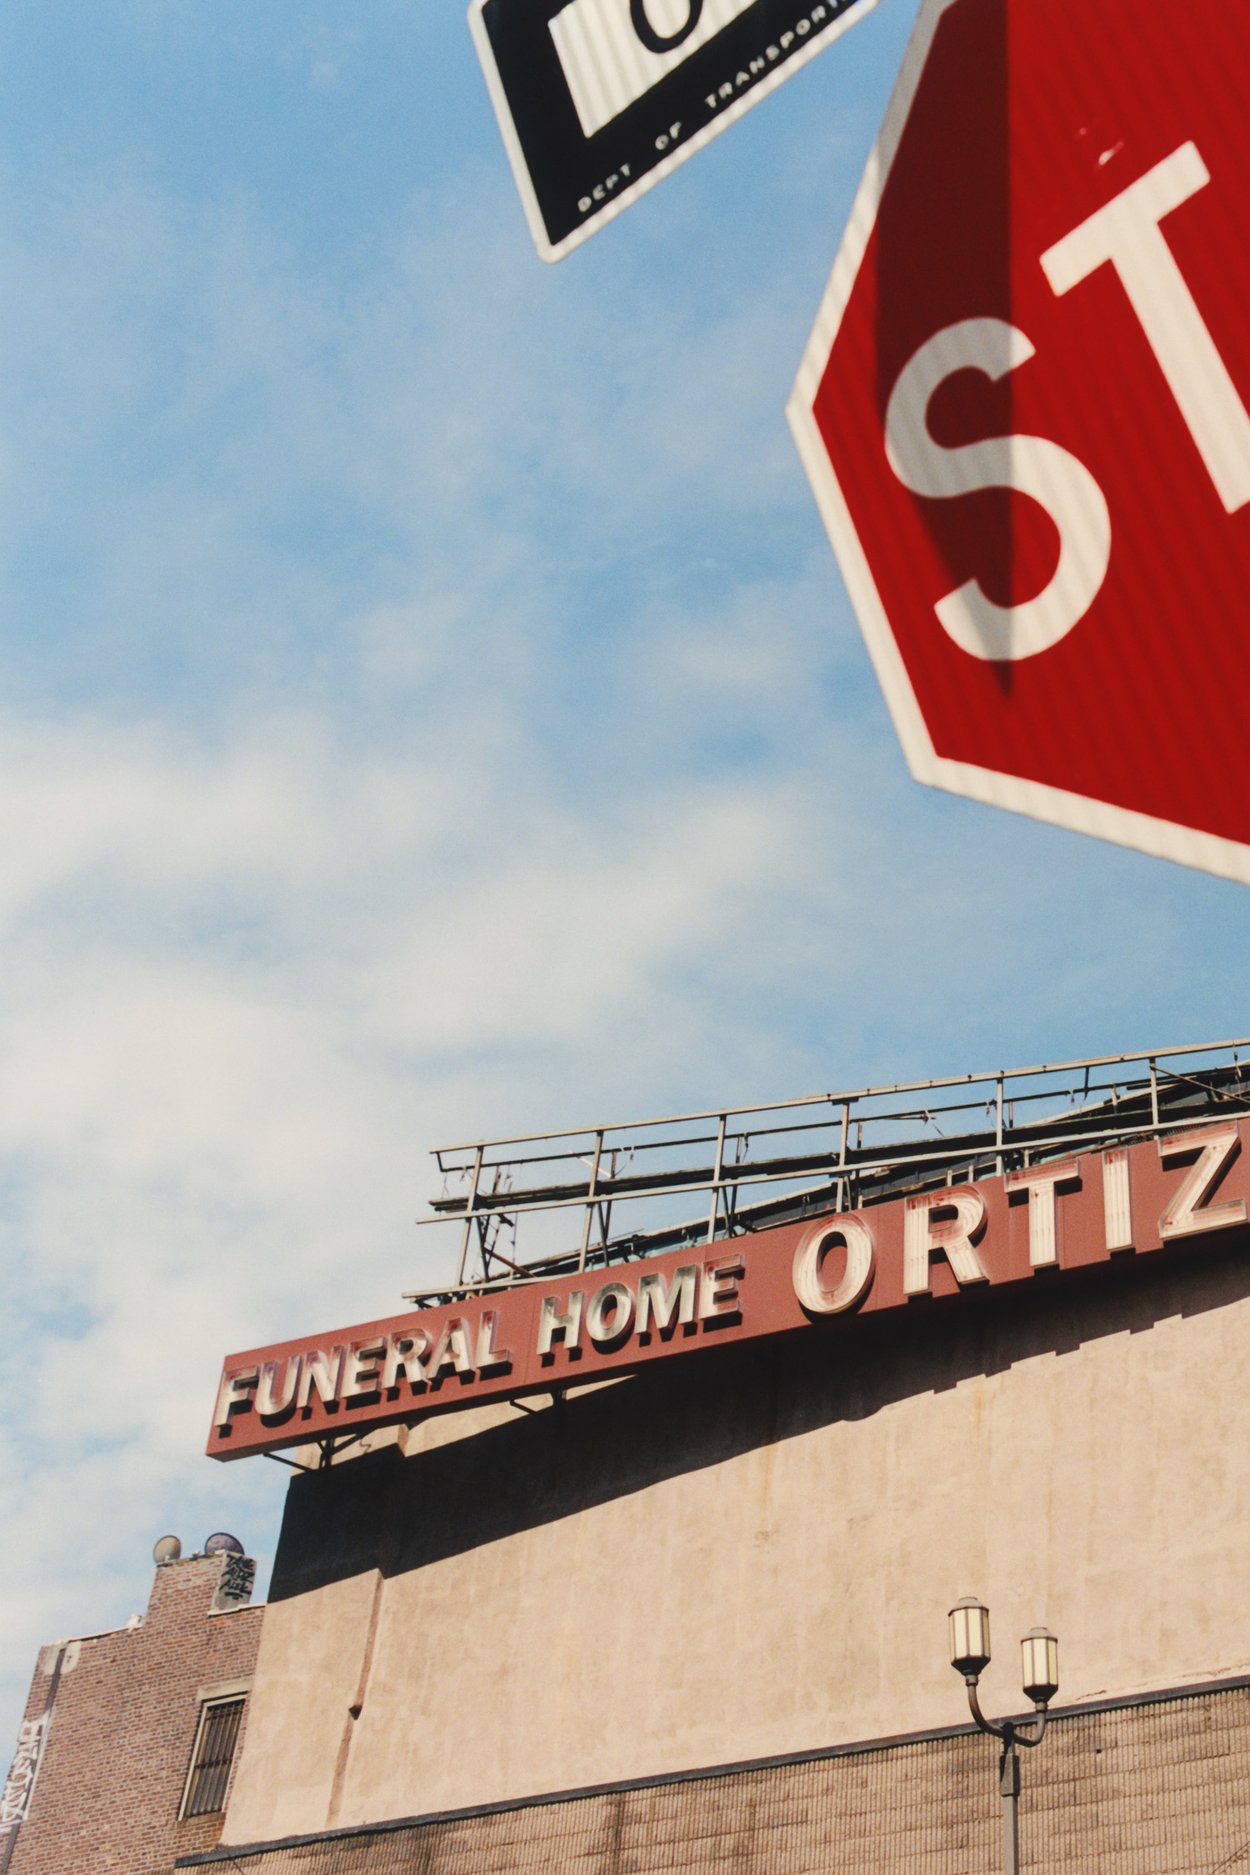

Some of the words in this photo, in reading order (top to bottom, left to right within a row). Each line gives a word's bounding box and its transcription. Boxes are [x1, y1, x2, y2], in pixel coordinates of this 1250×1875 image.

[577, 162, 631, 213] DEPT
[655, 121, 682, 150] OF
[214, 1310, 513, 1430] FUNERAL
[536, 1253, 746, 1357] HOME
[792, 1119, 1249, 1315] ORTIZ
